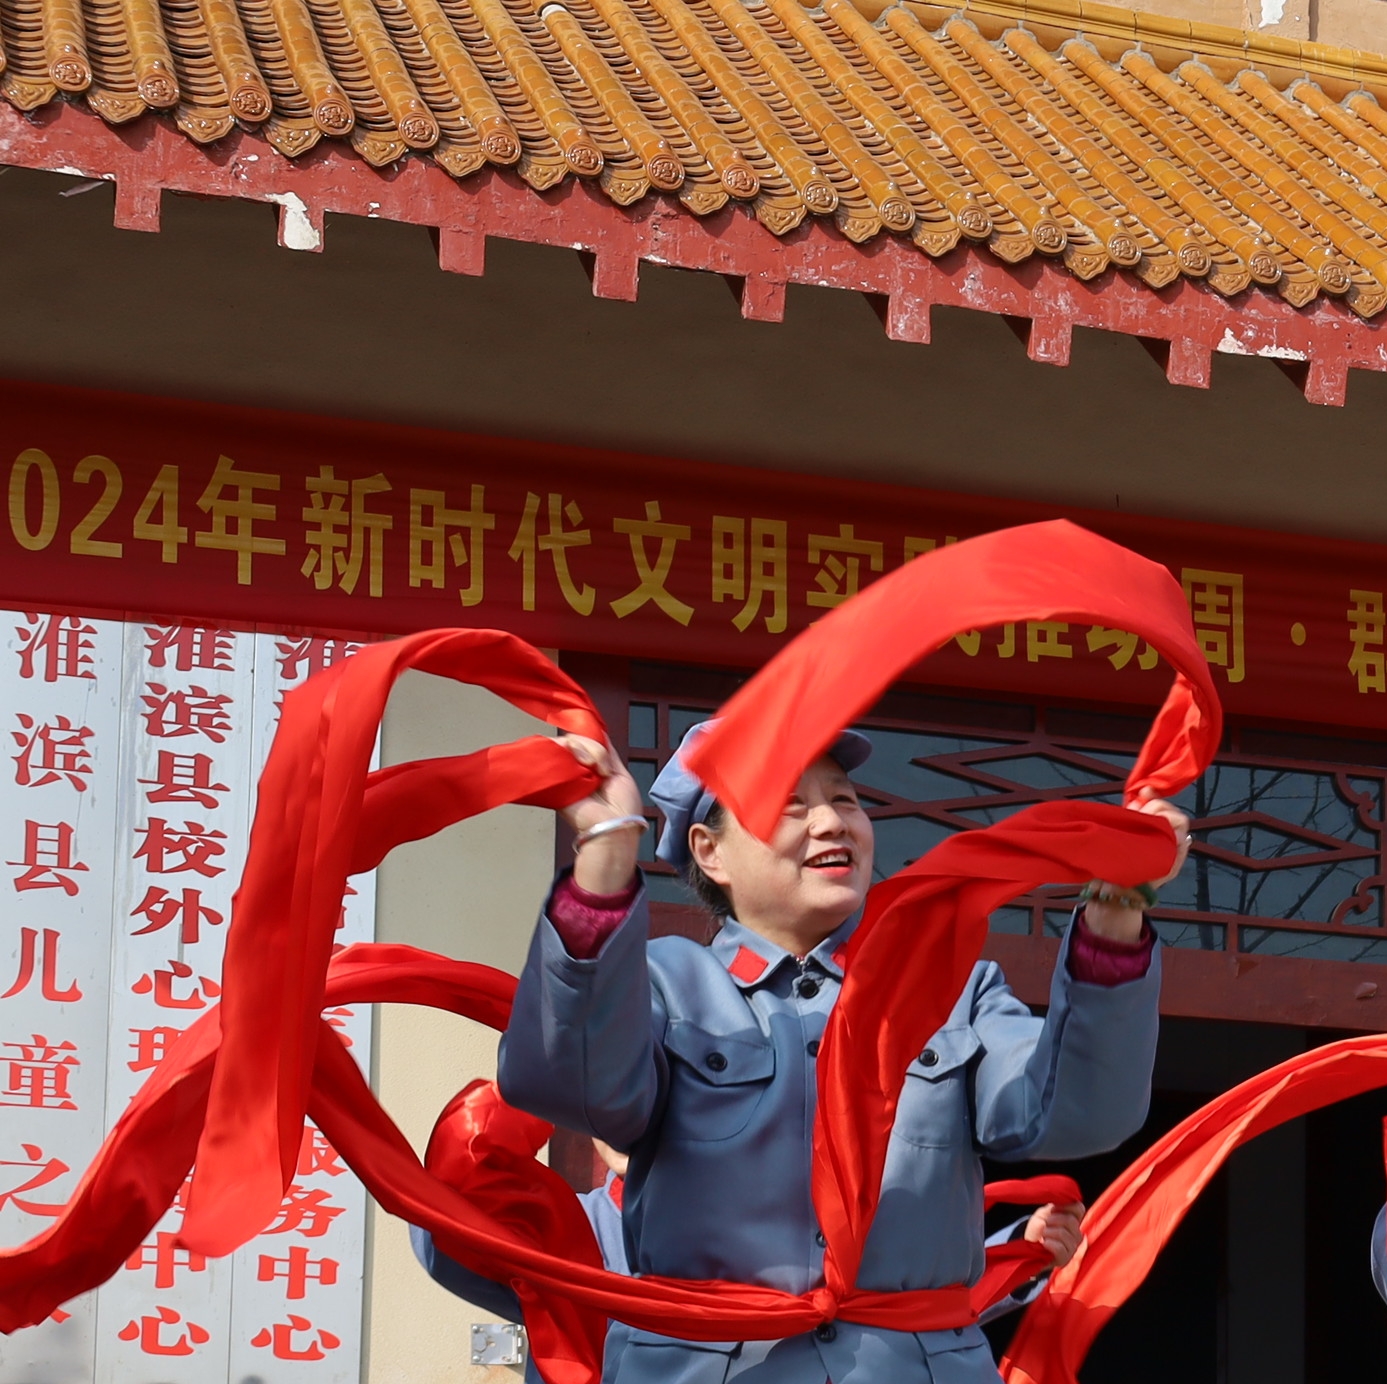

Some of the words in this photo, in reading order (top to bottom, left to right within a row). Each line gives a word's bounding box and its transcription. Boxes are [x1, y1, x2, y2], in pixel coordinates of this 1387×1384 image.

[0, 611, 98, 1324] 淮滨县儿童之
